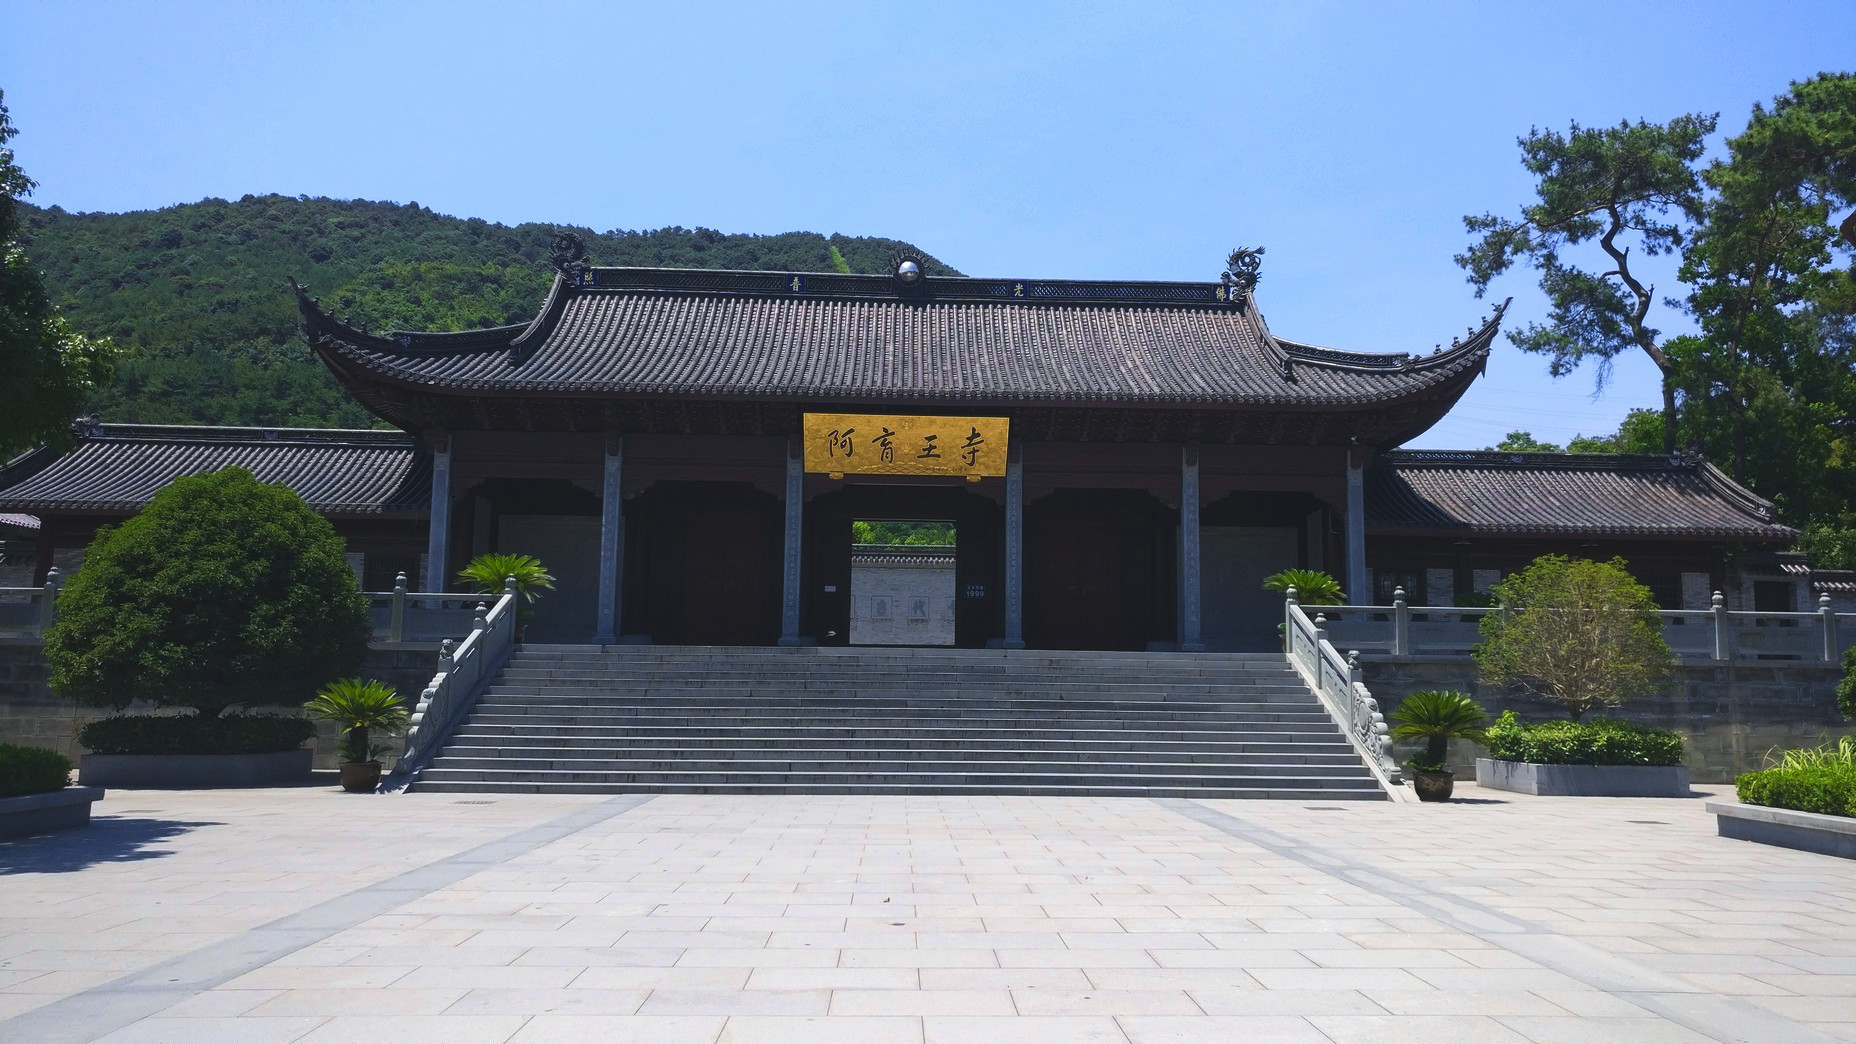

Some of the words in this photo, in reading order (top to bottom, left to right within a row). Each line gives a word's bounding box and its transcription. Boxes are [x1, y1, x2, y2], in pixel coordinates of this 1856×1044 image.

[790, 276, 802, 291] 普
[1014, 283, 1024, 297] 光
[827, 427, 985, 467] 阿育王寺
